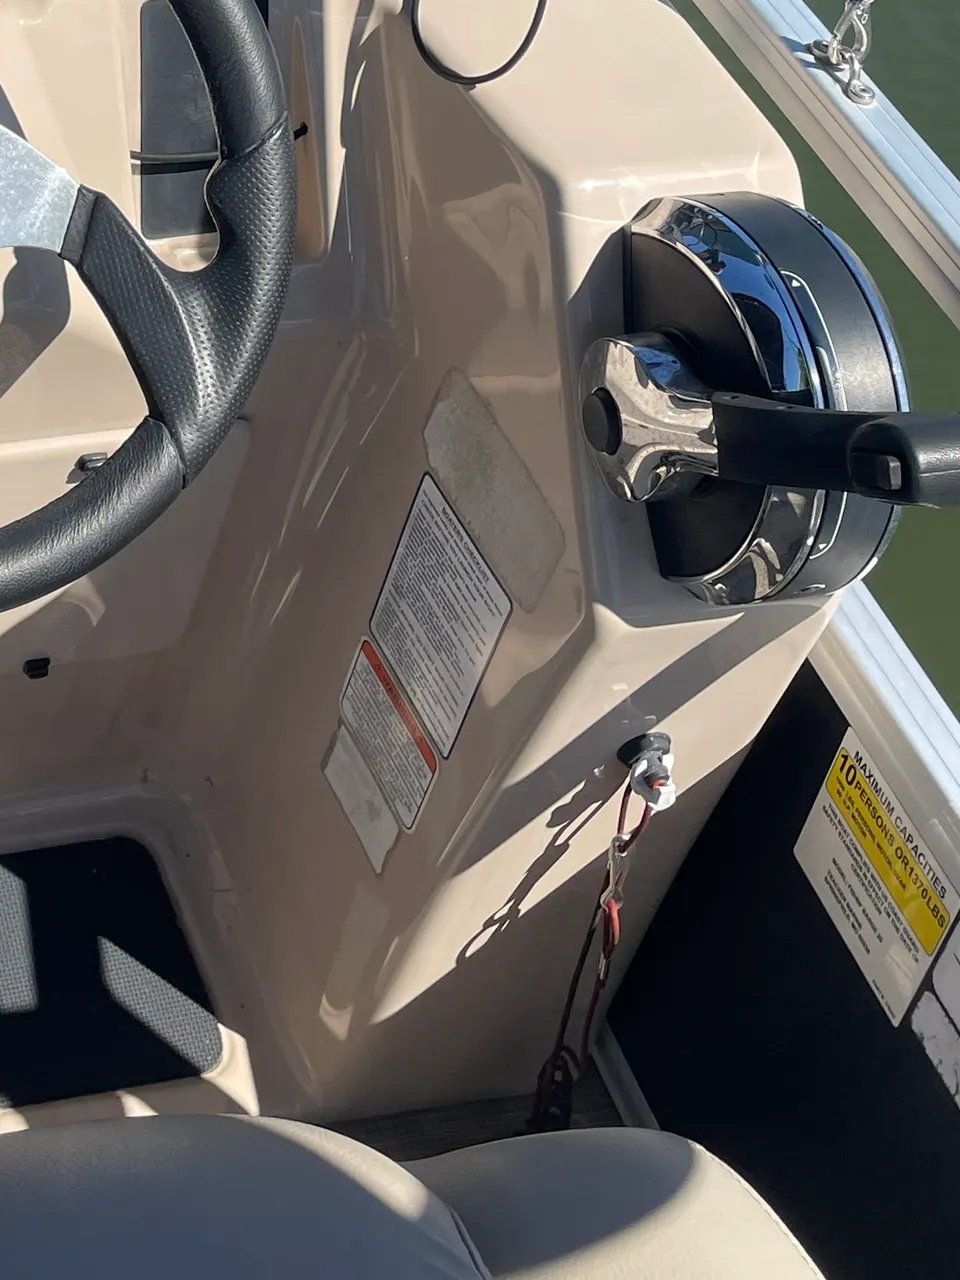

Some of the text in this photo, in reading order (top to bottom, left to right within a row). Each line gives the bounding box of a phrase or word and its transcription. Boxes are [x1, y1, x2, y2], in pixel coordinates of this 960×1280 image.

[840, 752, 858, 786] 10
[853, 780, 896, 848] PERSONS
[893, 844, 910, 871] OR
[907, 865, 928, 899] 1370
[925, 894, 946, 929] LBS
[853, 750, 948, 900] MAXIMUM CAPACITIES
